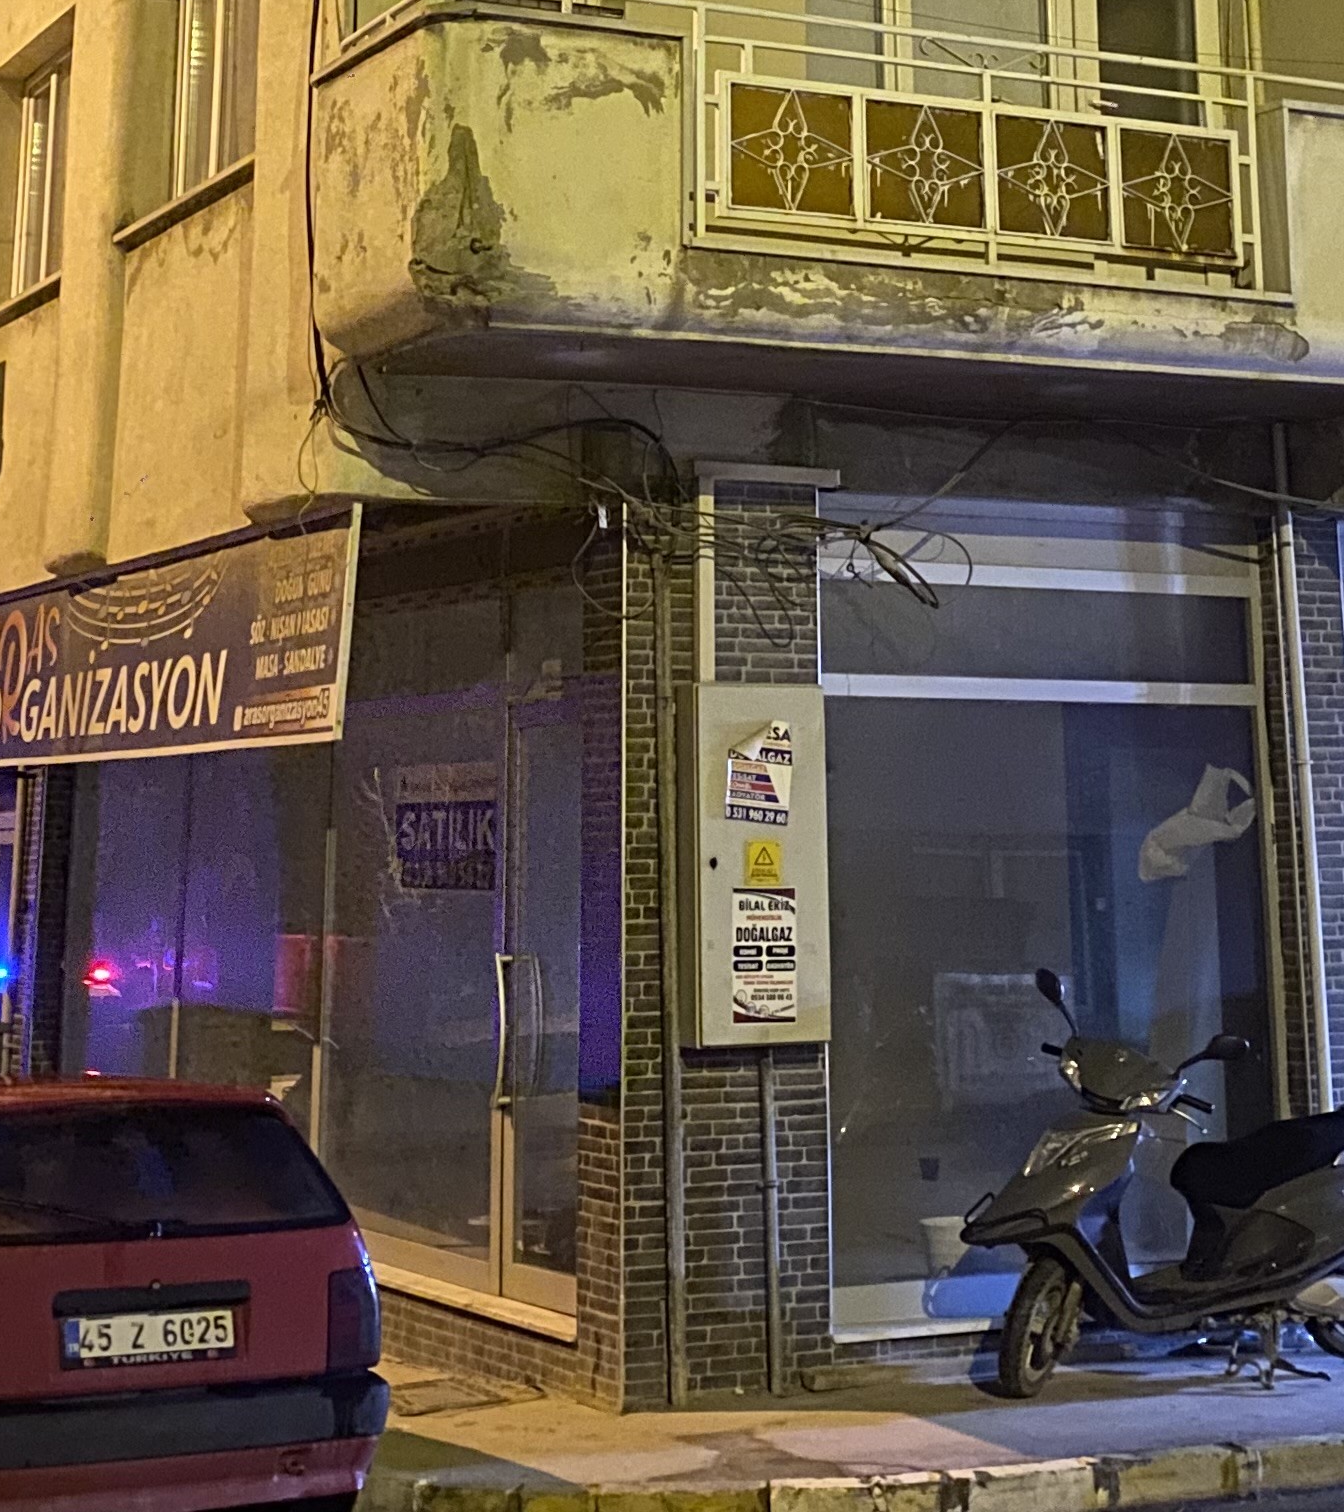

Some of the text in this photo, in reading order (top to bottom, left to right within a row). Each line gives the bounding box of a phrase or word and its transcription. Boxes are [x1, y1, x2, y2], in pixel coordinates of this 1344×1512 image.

[255, 653, 278, 681] MASA
[283, 644, 326, 676] SANDALYE
[732, 806, 747, 820] 531
[749, 808, 764, 822] 960
[764, 810, 775, 823] 29
[776, 812, 787, 824] 60
[399, 809, 495, 851] SATILIK
[738, 898, 791, 912] BİLAL EKİZ
[736, 923, 793, 943] DOĞALGAZ
[81, 1315, 229, 1353] 45 Z 6025
